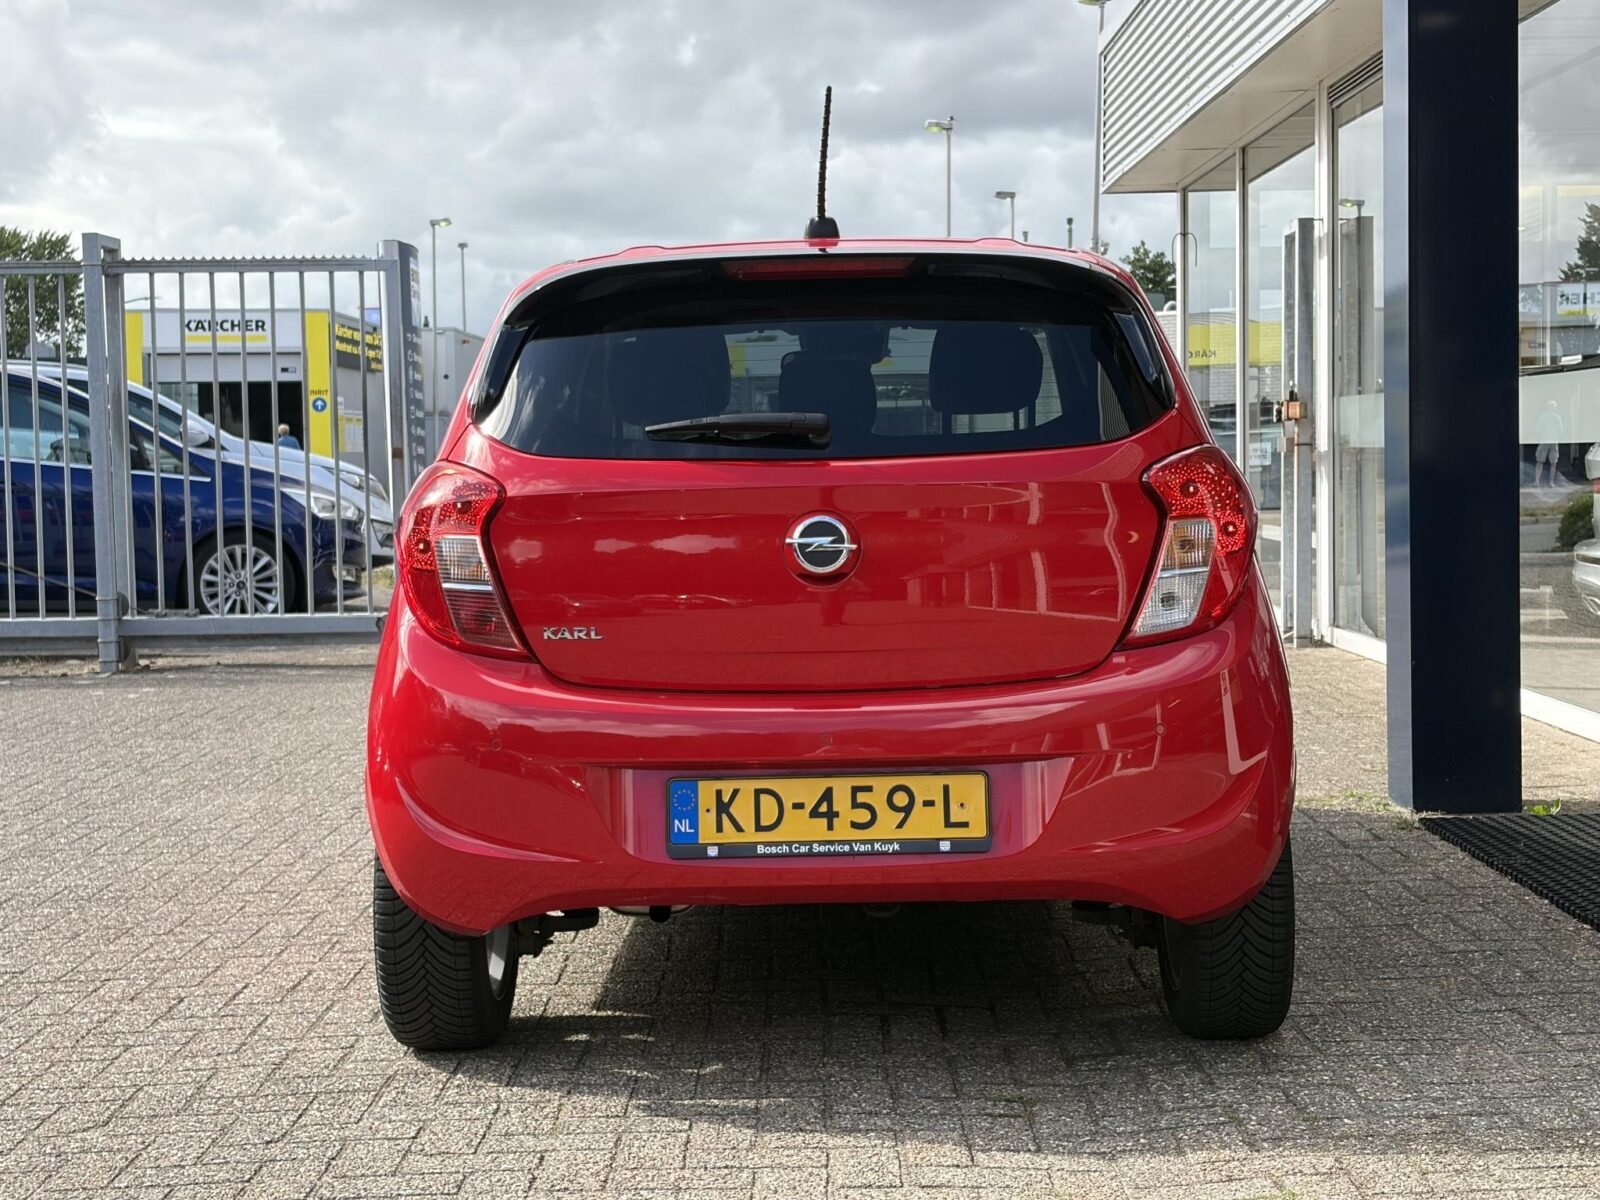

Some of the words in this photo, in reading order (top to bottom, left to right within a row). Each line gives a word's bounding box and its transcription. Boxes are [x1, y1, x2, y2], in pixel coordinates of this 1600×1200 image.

[543, 627, 604, 640] KARL
[715, 783, 970, 833] KD-459-L
[674, 819, 695, 833] NL
[757, 844, 789, 854] Bosch
[792, 844, 811, 853] Car
[812, 843, 850, 853] Service
[852, 842, 873, 852] Van
[874, 841, 901, 853] Kuyk
